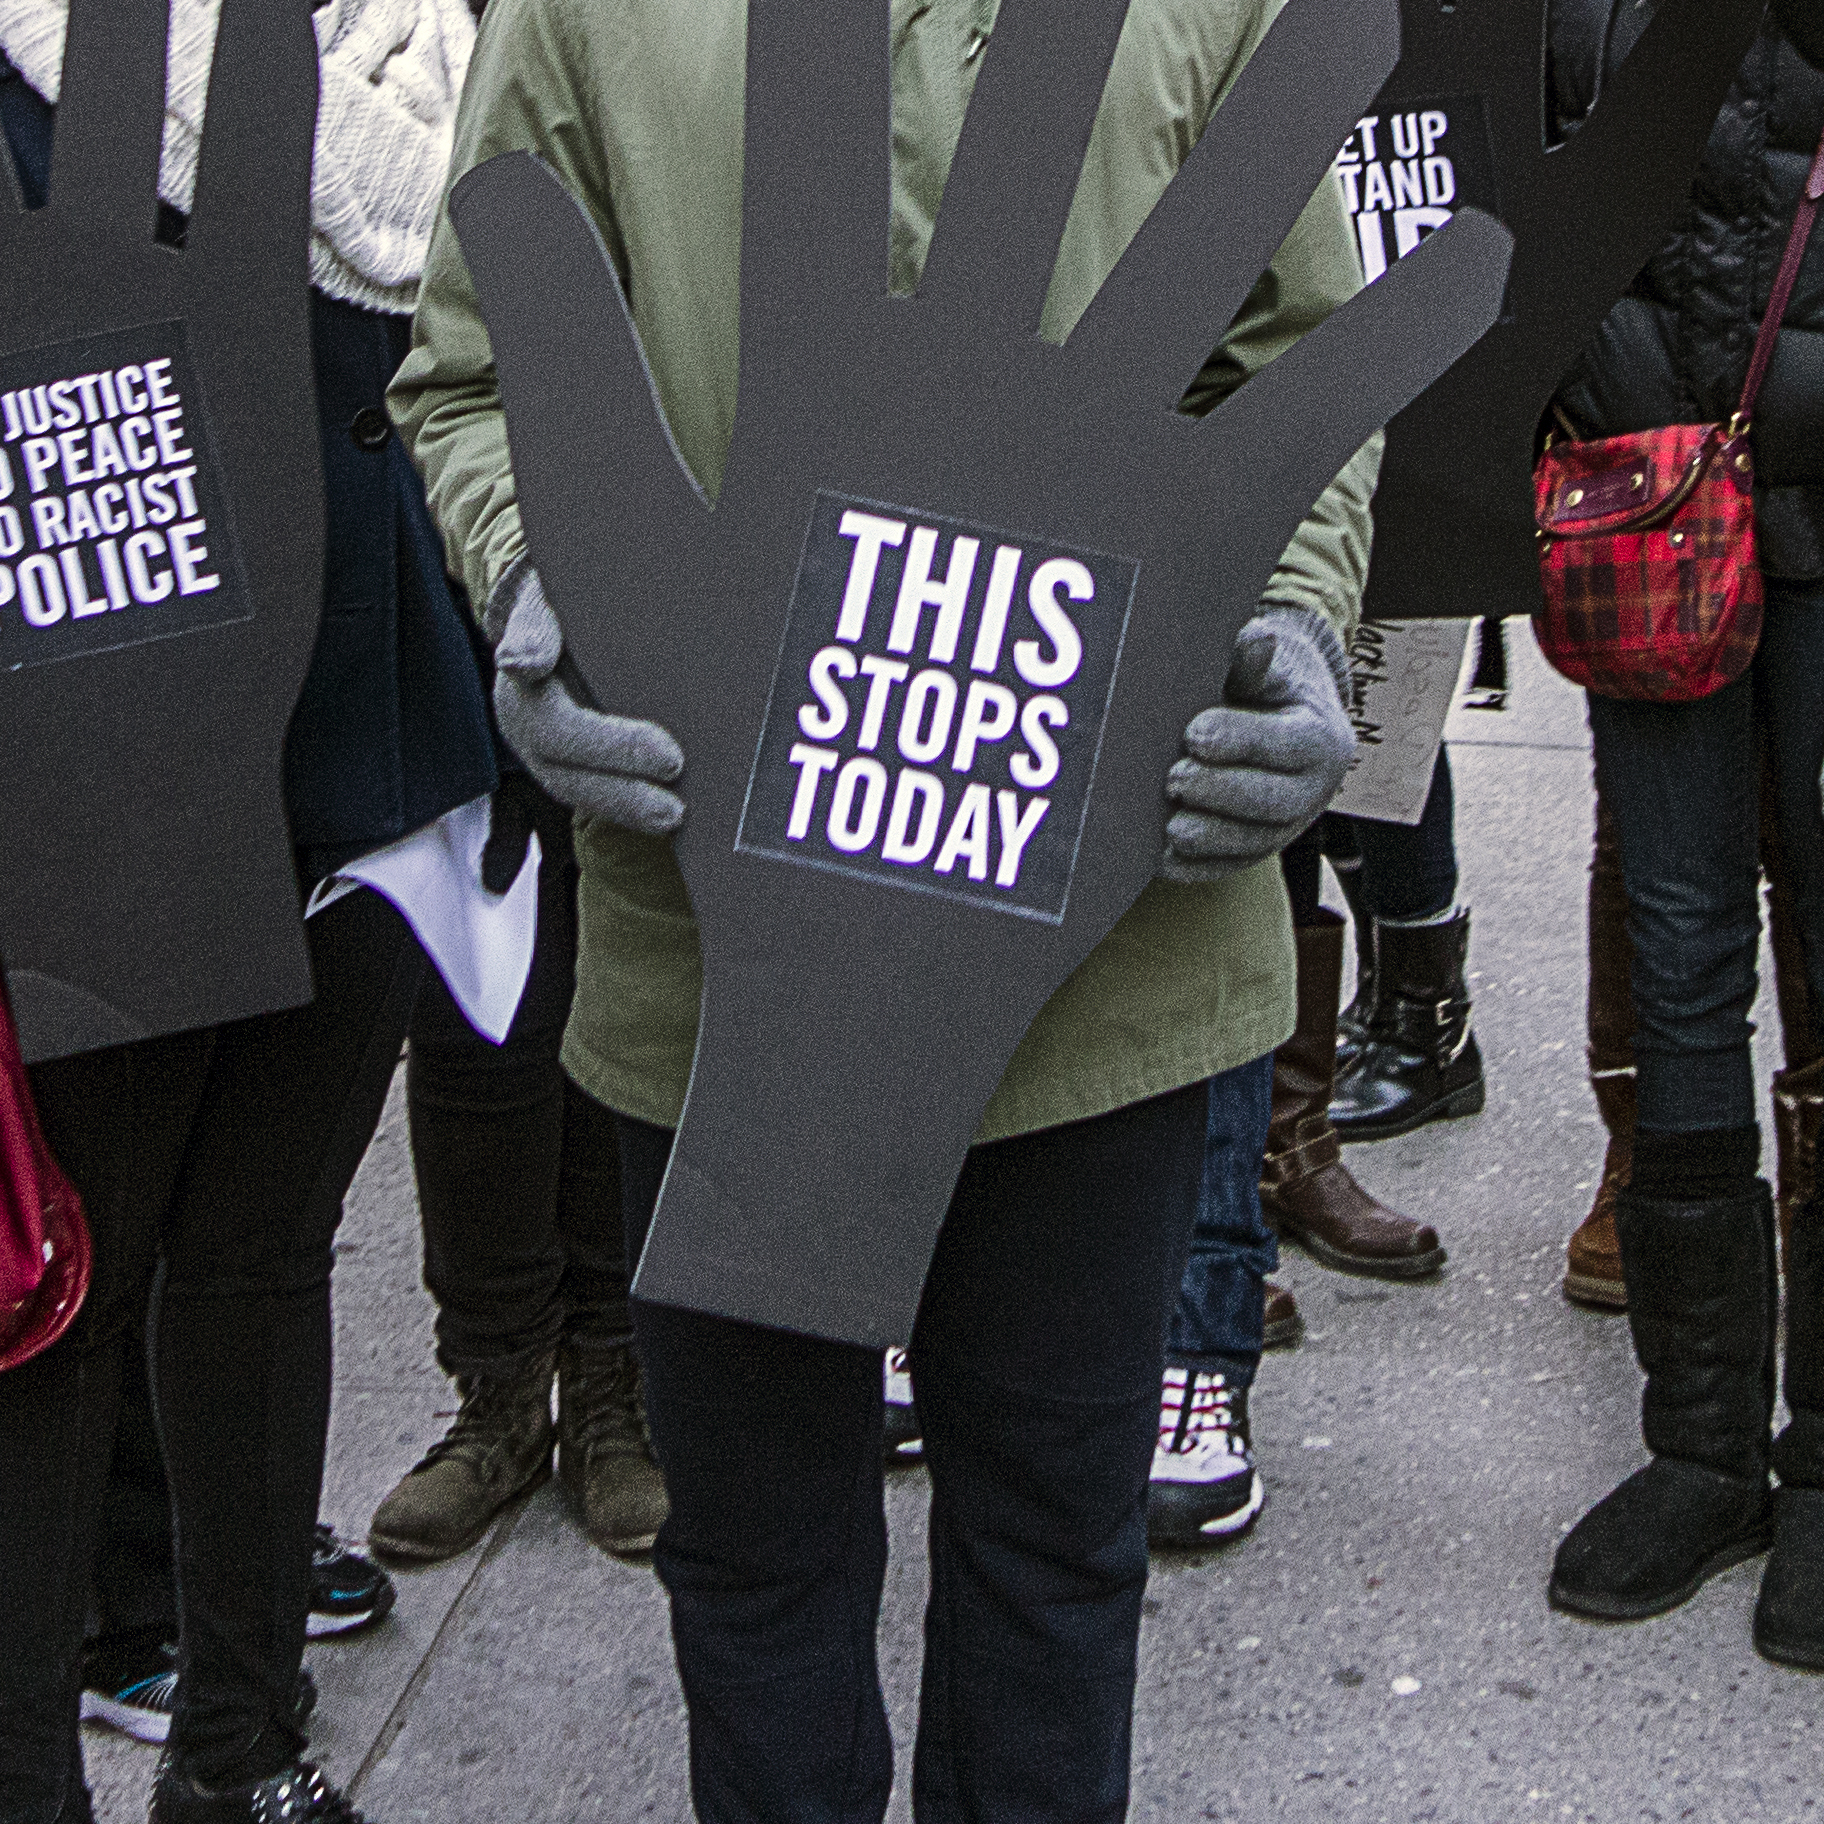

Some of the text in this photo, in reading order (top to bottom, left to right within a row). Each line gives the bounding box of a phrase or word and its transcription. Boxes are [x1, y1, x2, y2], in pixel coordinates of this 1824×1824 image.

[1390, 109, 1448, 159] UP
[1336, 155, 1457, 214] TAND
[1, 357, 182, 442] JUSTICE
[23, 406, 193, 495] PEACE
[32, 466, 205, 550] RACIST
[837, 507, 1095, 689] THIS
[798, 646, 1070, 790] STOPS
[787, 745, 1051, 890] TODAY
